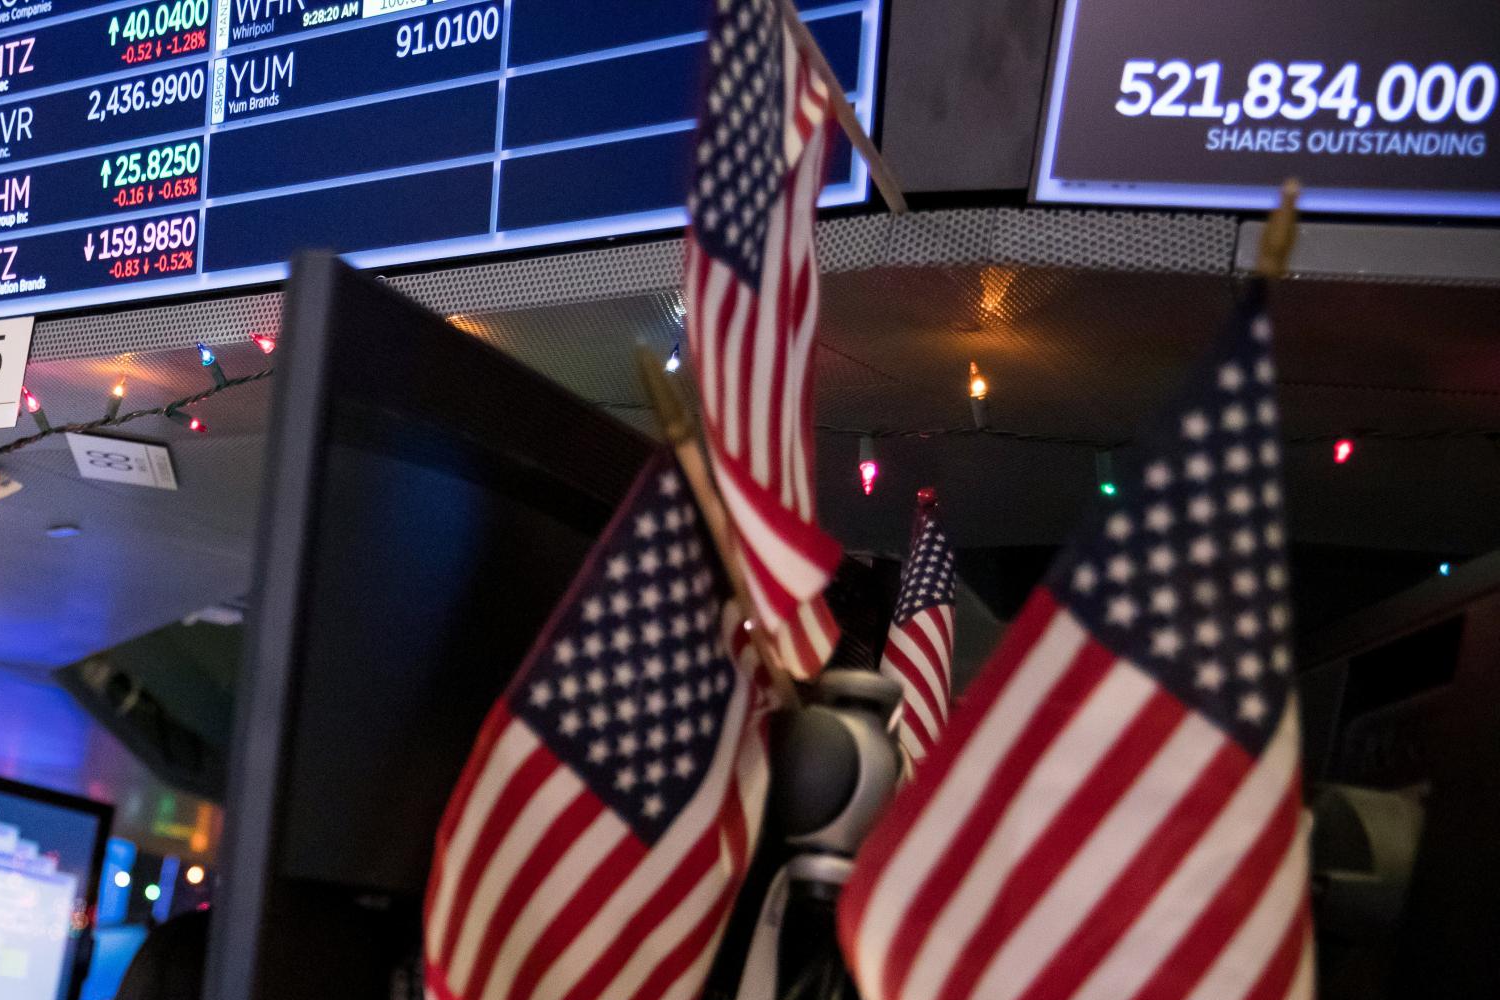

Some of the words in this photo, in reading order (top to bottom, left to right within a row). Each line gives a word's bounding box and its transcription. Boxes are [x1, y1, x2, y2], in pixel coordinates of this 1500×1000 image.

[11, 1, 52, 20] Companies
[122, 0, 209, 42] 40.0400
[303, 7, 340, 27] 9:28:20
[341, 5, 358, 19] AM
[233, 18, 275, 40] Whirlpool
[395, 6, 499, 58] 91.0100
[121, 41, 152, 64] -0.52
[167, 30, 206, 55] -1.28%
[214, 67, 225, 115] S&P500
[230, 51, 294, 98] YUM
[87, 68, 205, 122] 2,436.9900
[228, 100, 248, 115] Yum
[249, 92, 279, 111] Brands
[1114, 59, 1498, 127] 521,834,000
[1205, 128, 1301, 153] SHARES
[1306, 129, 1486, 157] OUTSTANDING
[114, 142, 200, 187] 25.8250
[113, 186, 144, 207] -0.16
[159, 177, 198, 200] -0.63%
[98, 216, 196, 260] 159.9850
[109, 258, 140, 279] -0.83
[154, 250, 194, 272] -0.52%
[19, 275, 46, 293] Brands
